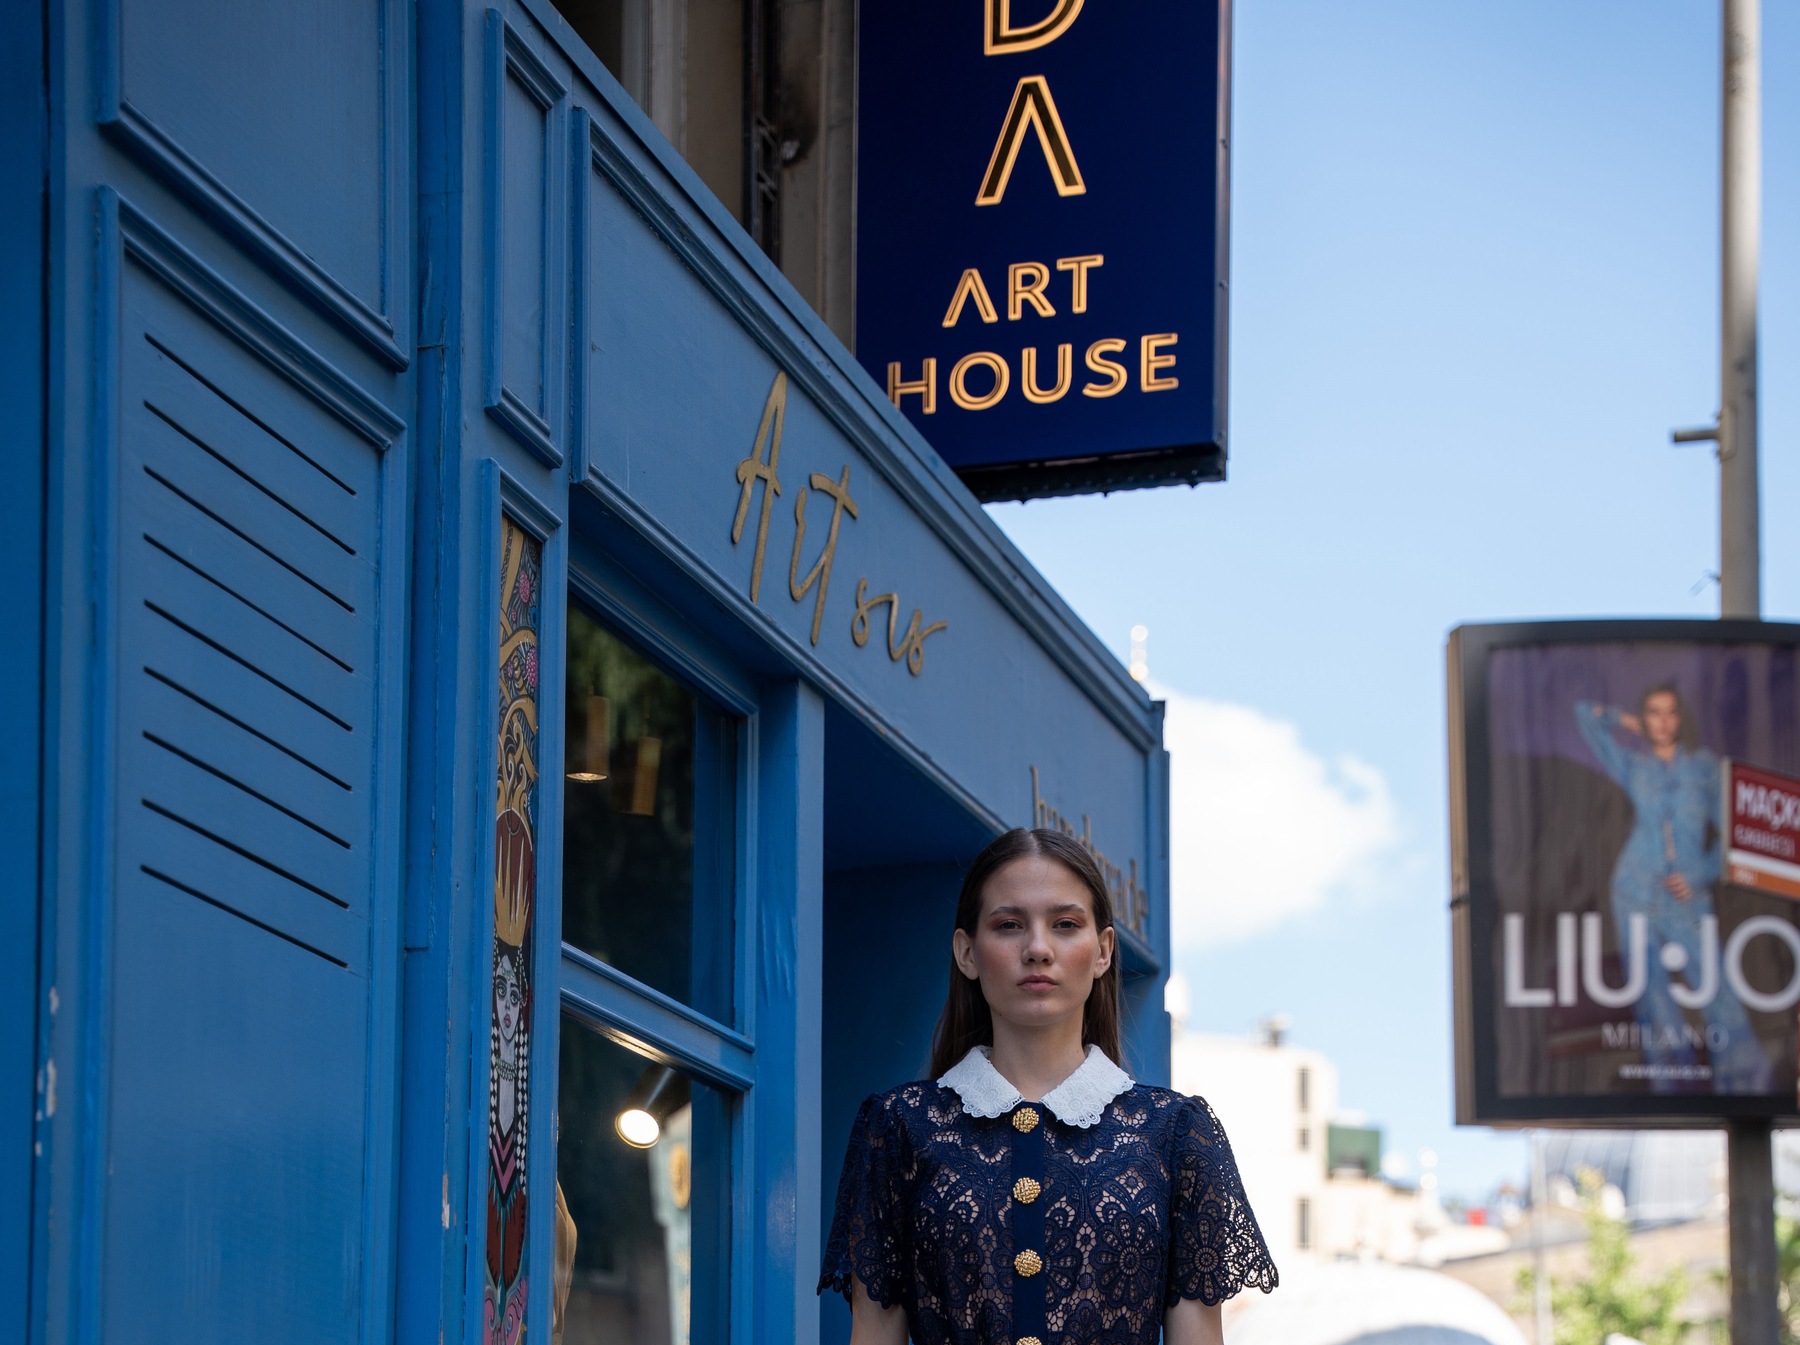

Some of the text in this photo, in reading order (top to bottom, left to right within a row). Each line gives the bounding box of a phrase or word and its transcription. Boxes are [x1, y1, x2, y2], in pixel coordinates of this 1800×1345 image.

[942, 254, 1104, 328] ART
[887, 332, 1179, 415] HOUSE
[1601, 1021, 1730, 1053] MILANO
